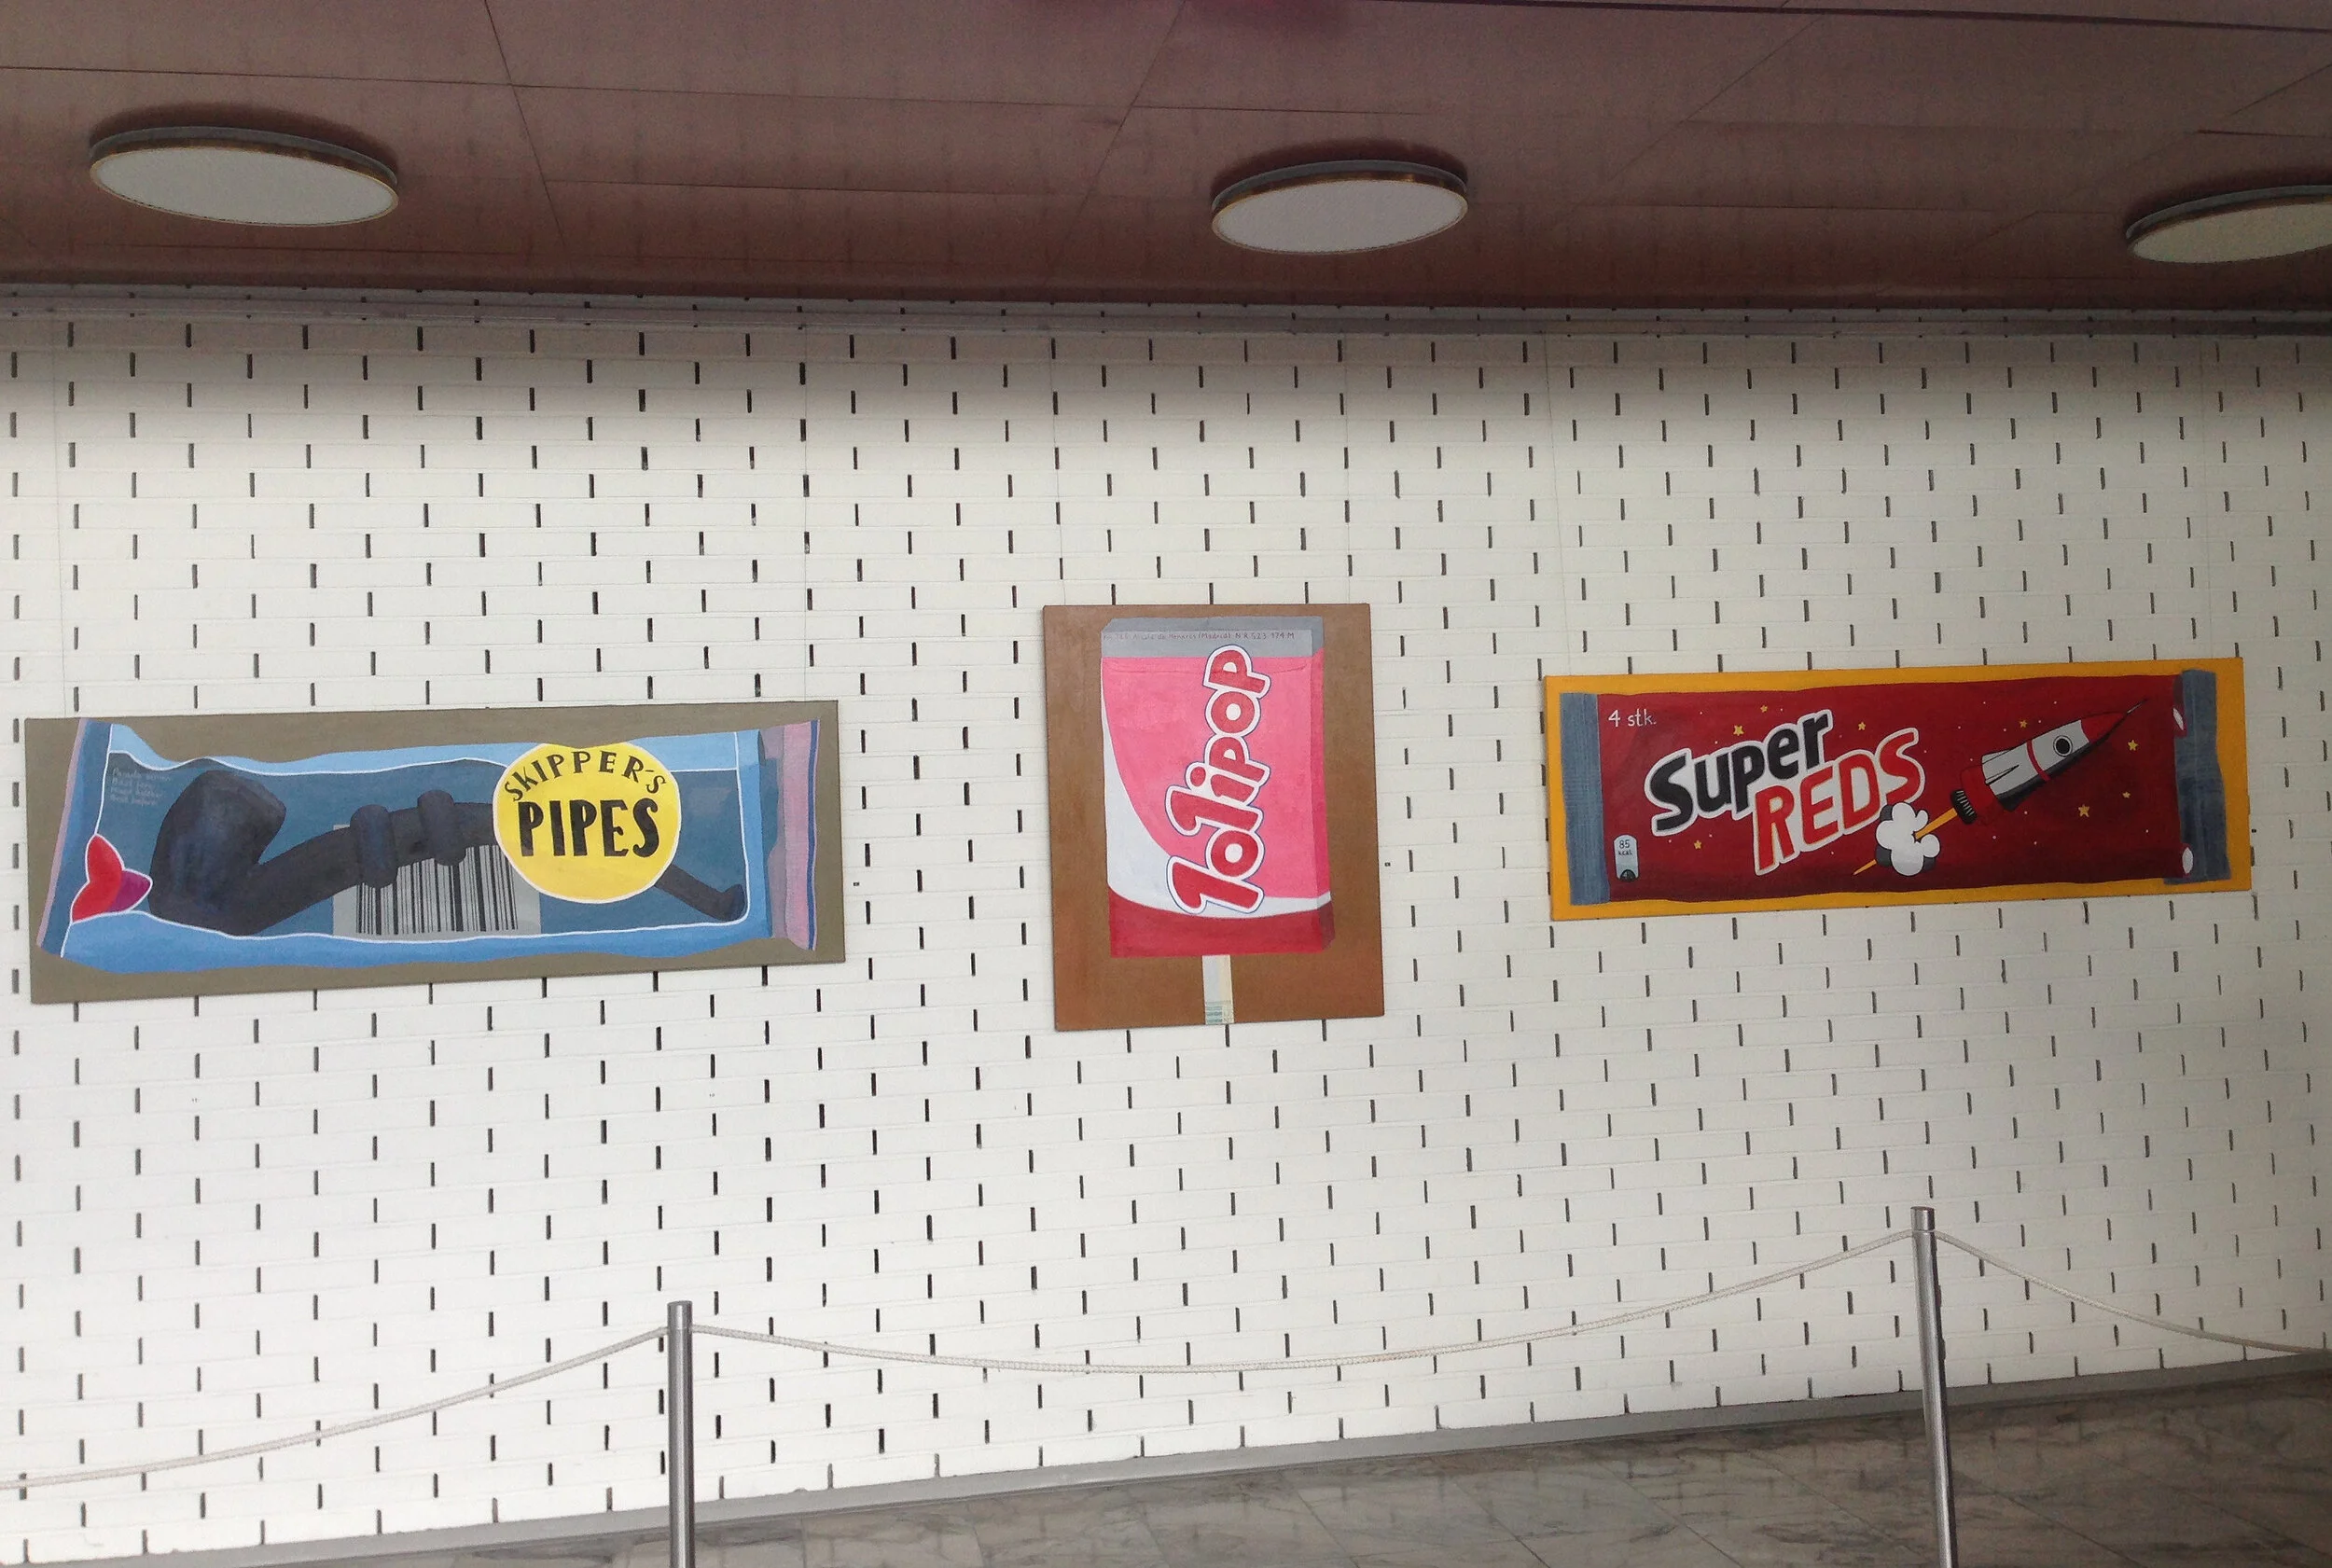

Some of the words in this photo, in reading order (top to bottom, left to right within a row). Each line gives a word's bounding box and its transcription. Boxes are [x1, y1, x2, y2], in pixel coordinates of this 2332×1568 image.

[1608, 709, 1621, 728] 4
[1627, 708, 1657, 727] stk.
[1647, 711, 1831, 834] Super
[1753, 729, 1922, 873] REDS
[518, 798, 660, 858] PIPES
[1619, 840, 1631, 849] 85
